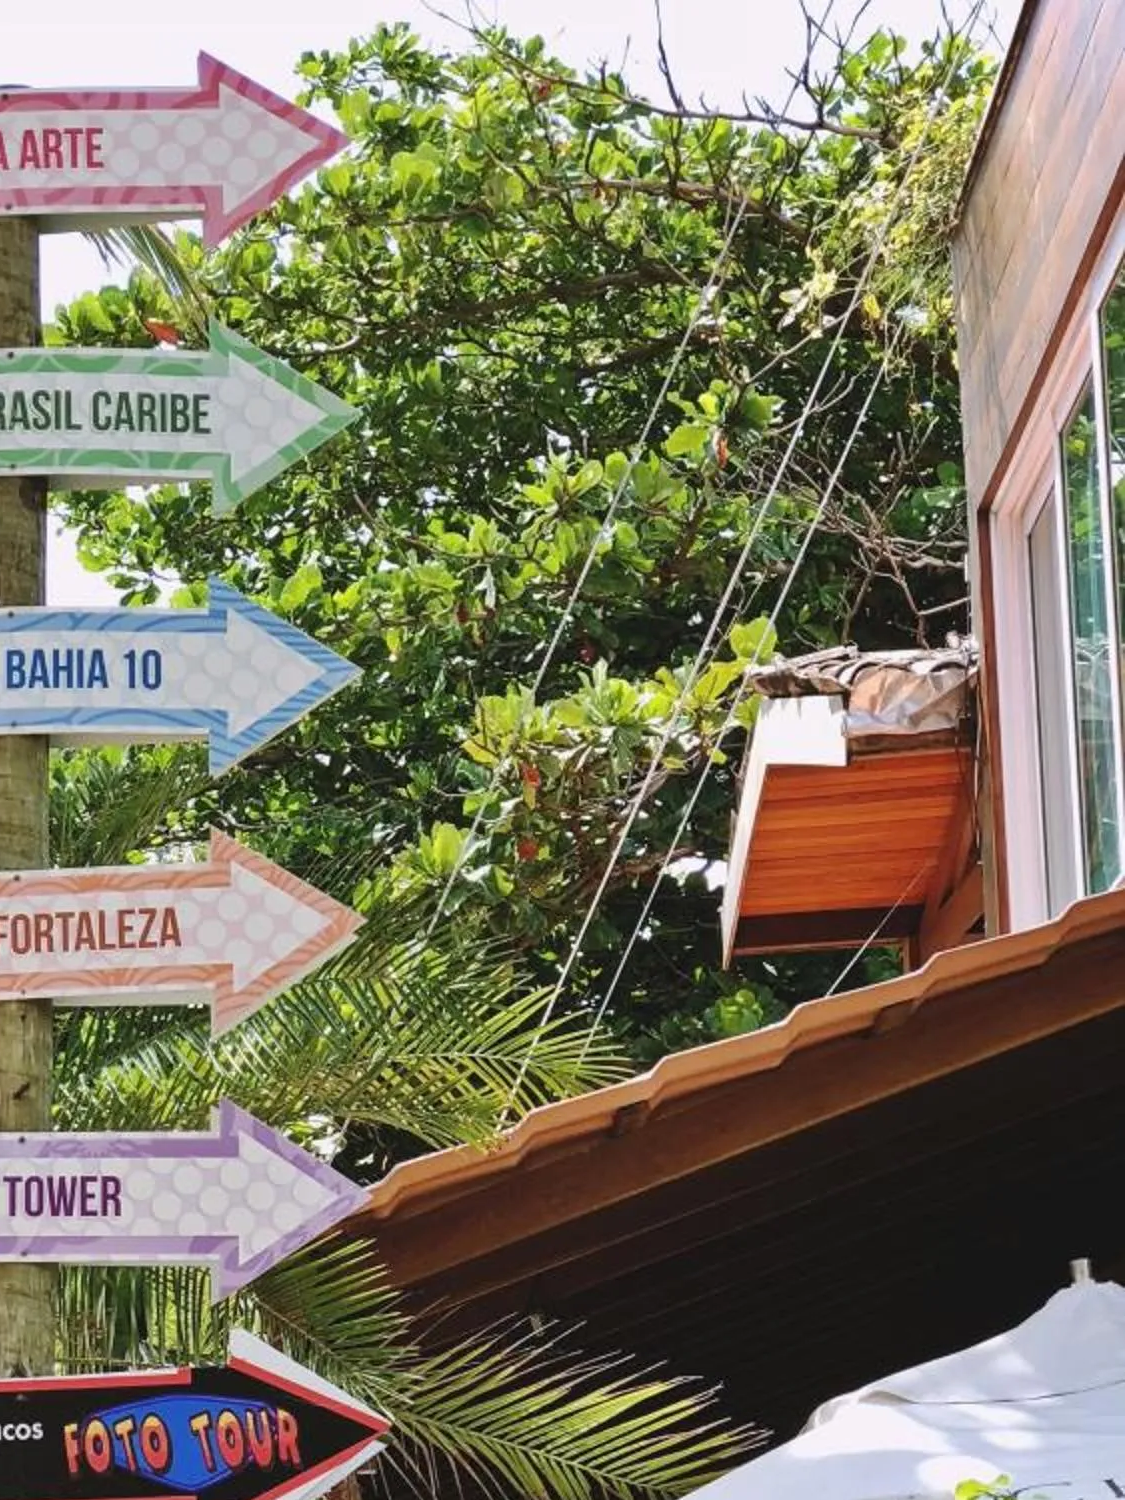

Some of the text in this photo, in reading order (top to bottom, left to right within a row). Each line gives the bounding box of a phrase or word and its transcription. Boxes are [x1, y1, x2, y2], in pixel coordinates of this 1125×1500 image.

[19, 127, 105, 169] ARTE
[90, 390, 213, 435] CARIBE
[5, 648, 109, 690] BAHIA
[123, 649, 163, 691] 10
[3, 1175, 122, 1217] TOWER
[63, 1407, 302, 1474] FOTO TOUR
